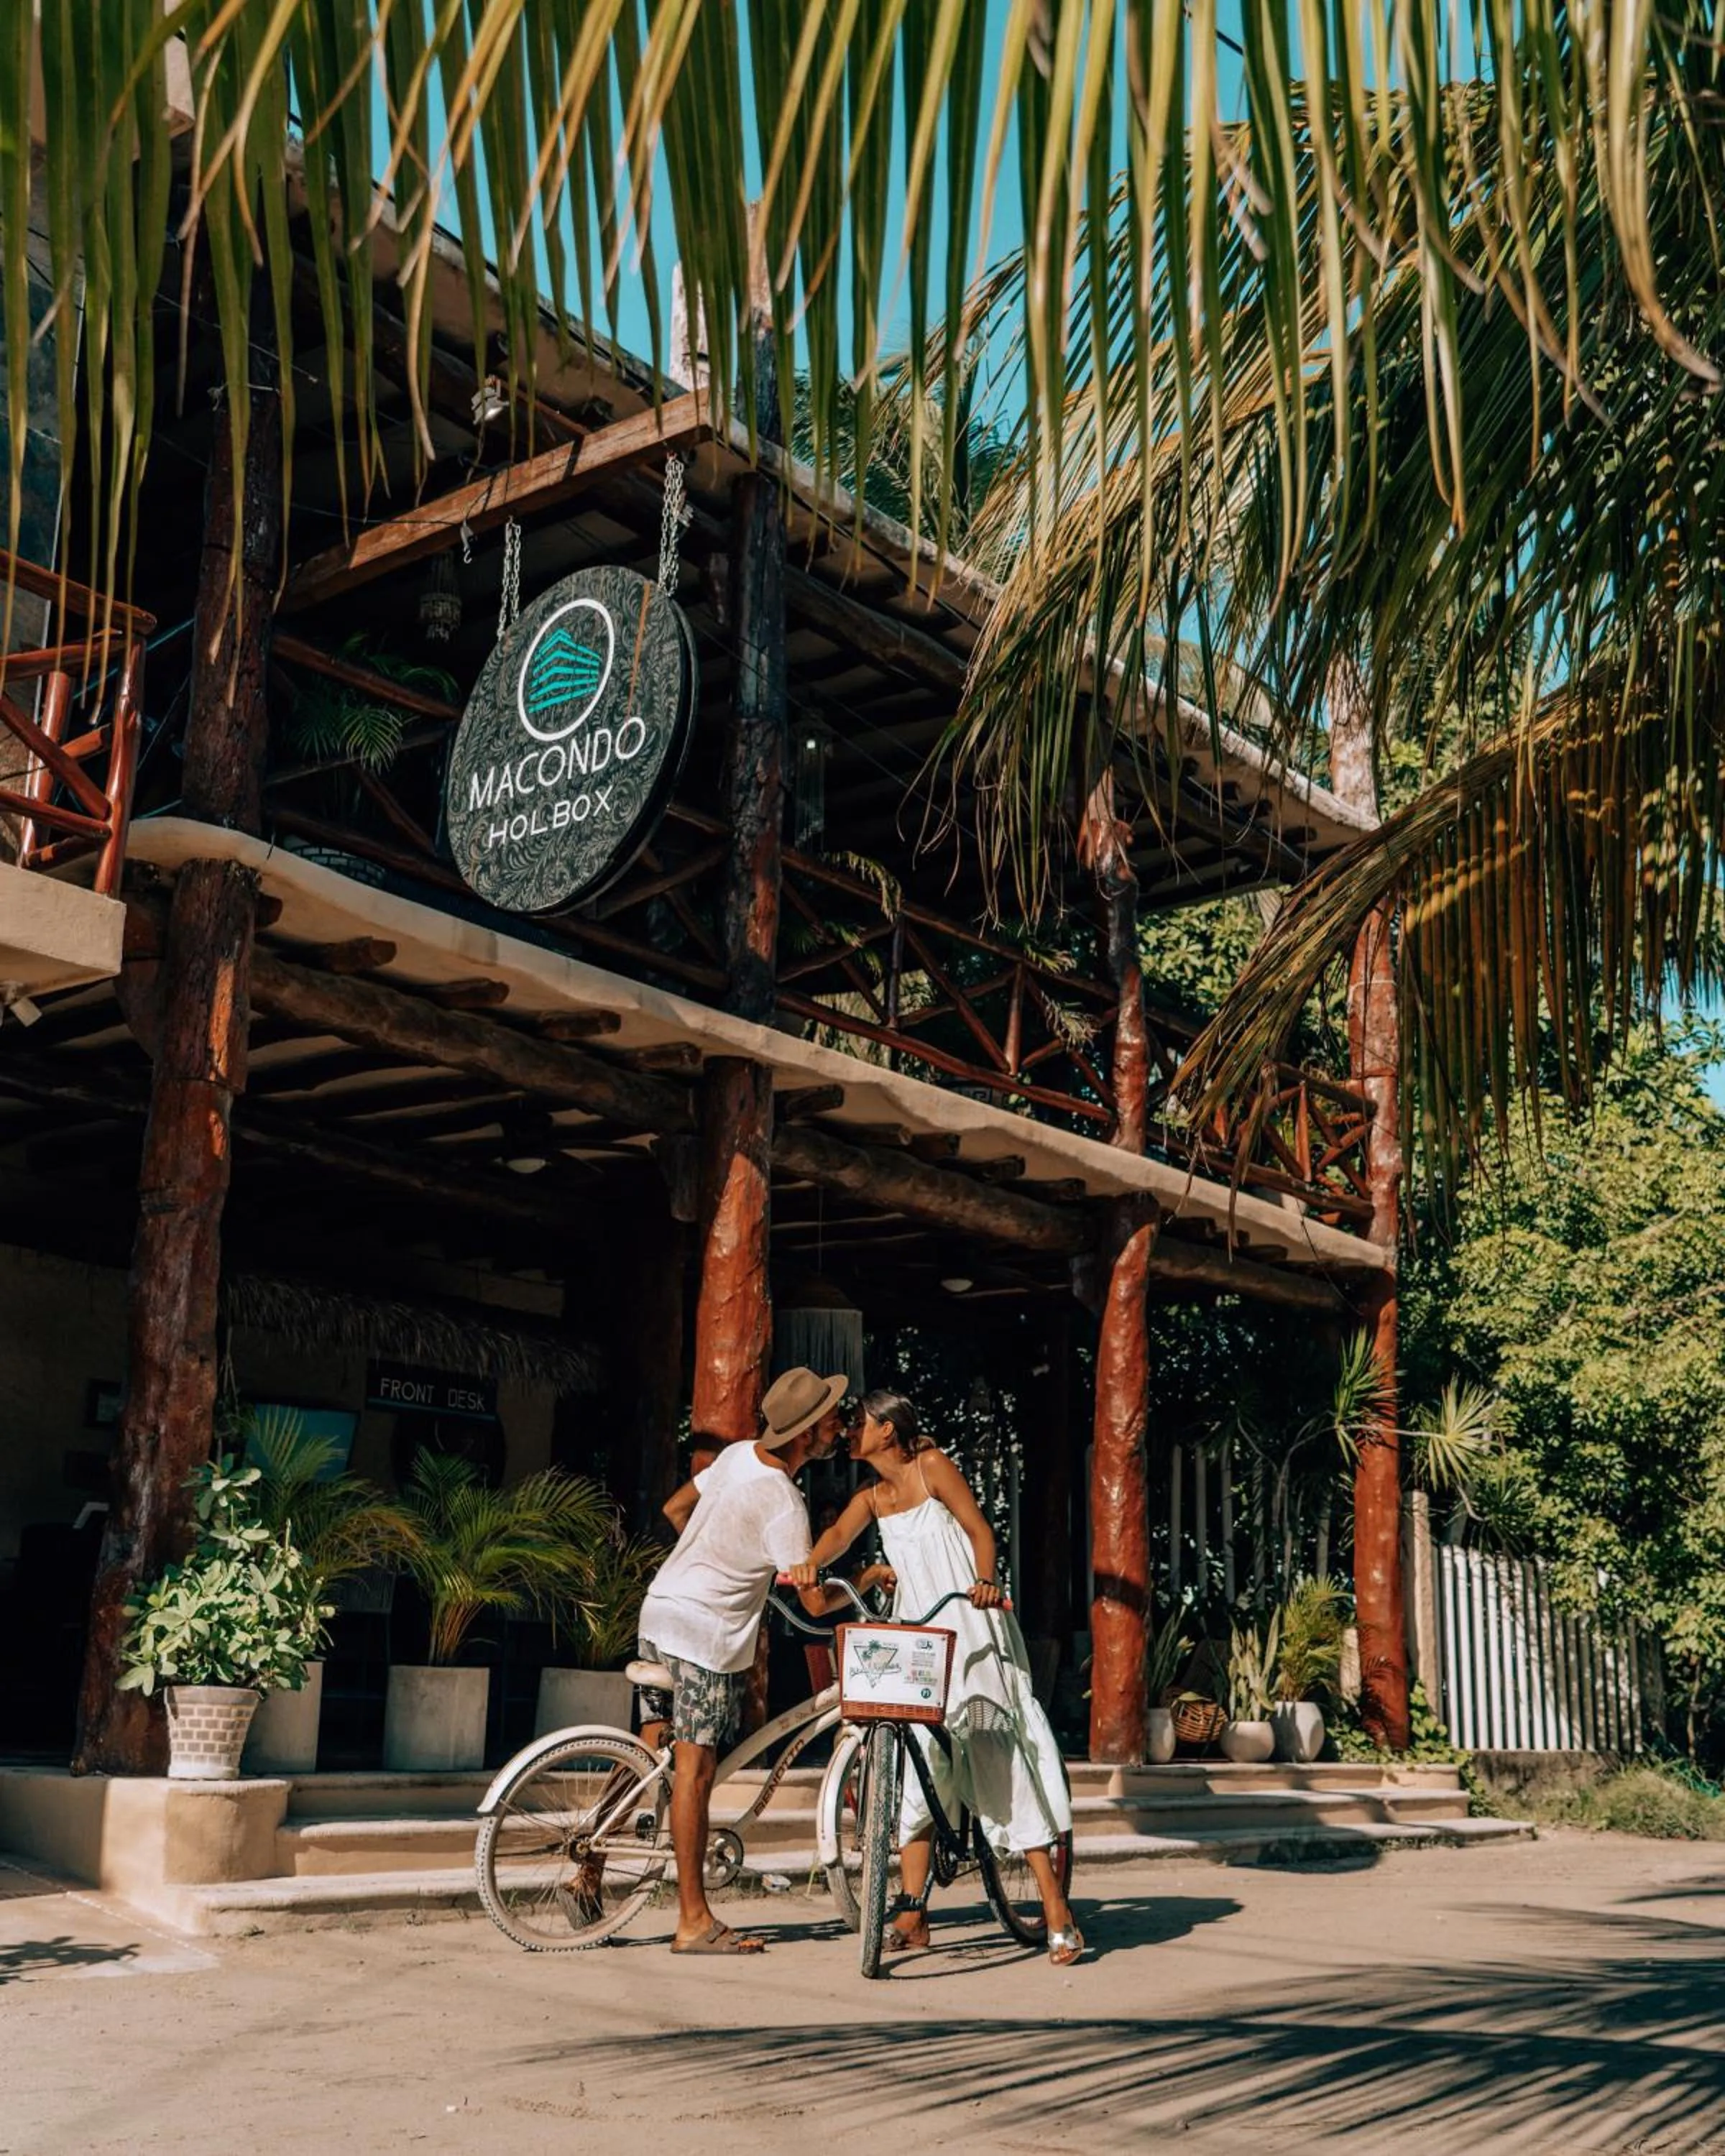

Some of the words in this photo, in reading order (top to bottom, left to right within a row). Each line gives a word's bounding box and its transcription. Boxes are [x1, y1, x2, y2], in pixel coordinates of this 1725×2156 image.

[469, 717, 646, 811] MACONDO
[488, 785, 612, 848] HOLBOX
[380, 1377, 435, 1404] FRONT
[448, 1388, 486, 1412] DESK
